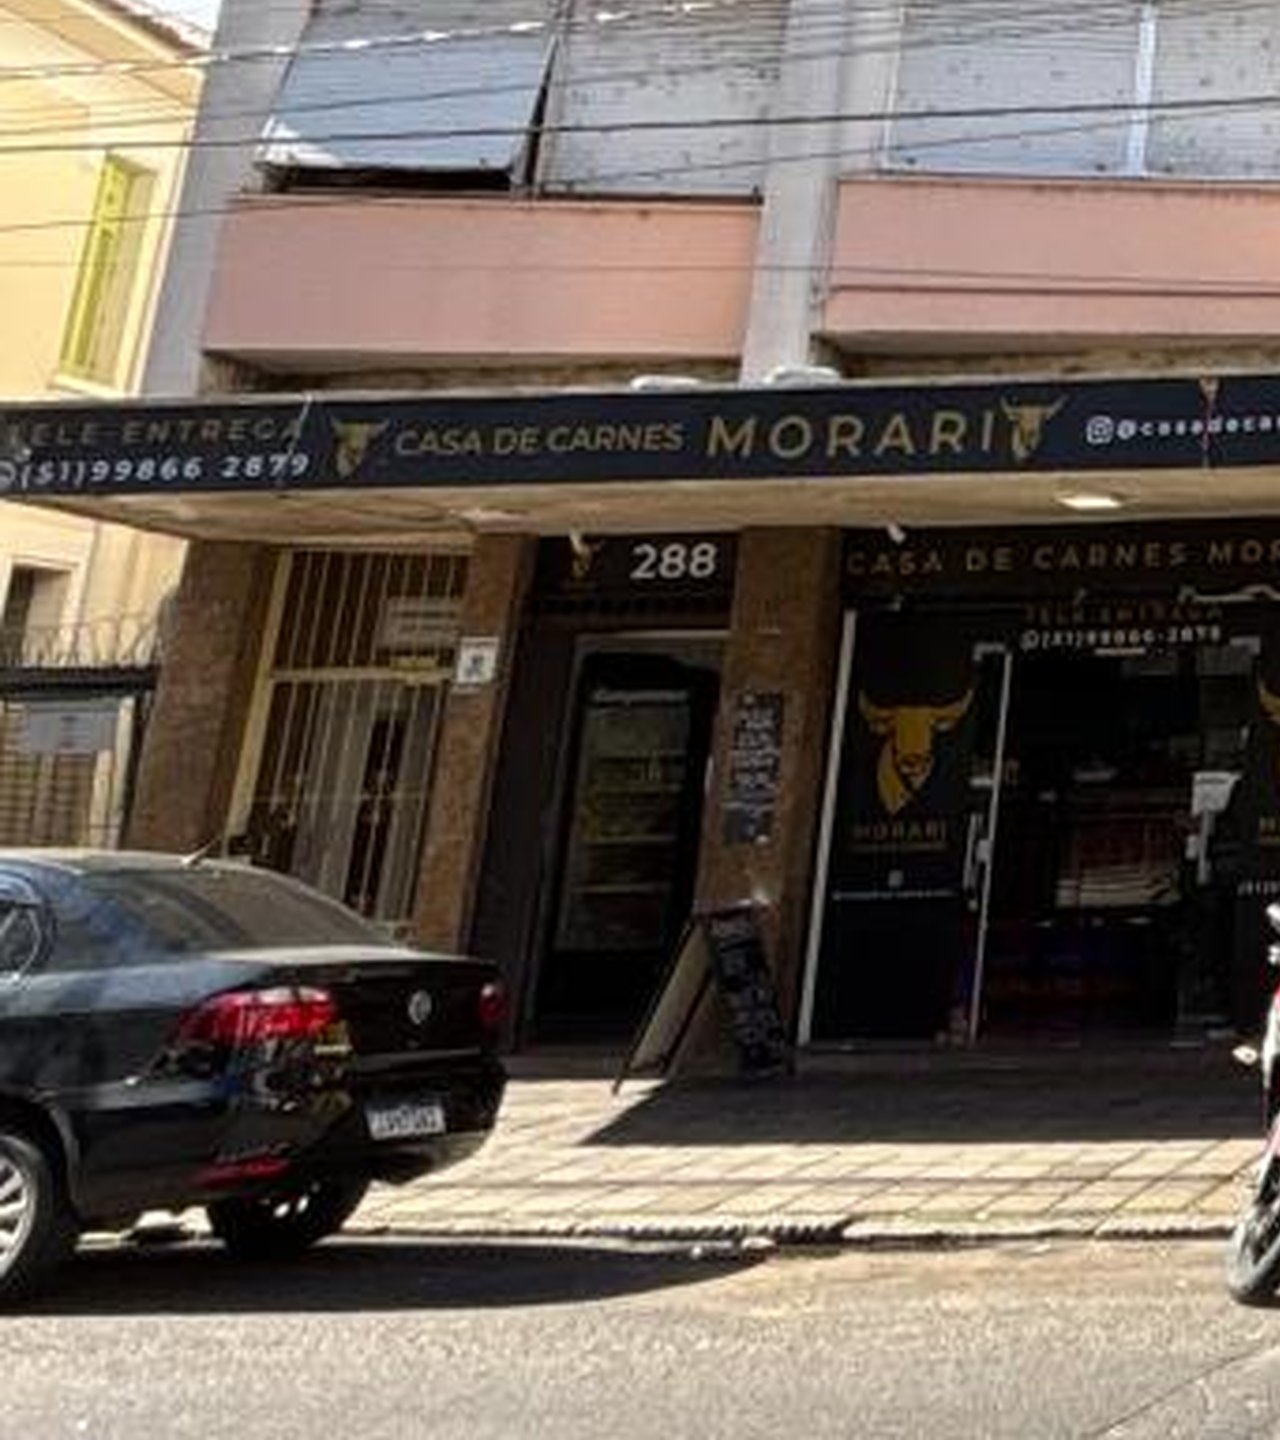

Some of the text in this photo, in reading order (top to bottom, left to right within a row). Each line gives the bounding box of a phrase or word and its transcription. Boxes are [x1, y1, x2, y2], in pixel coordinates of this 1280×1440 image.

[395, 411, 995, 459] CASA DE CARNES MORARI
[221, 452, 311, 478] 2879
[629, 542, 717, 580] 288
[846, 549, 944, 577] CASA
[965, 546, 1014, 572] DE
[1033, 541, 1188, 570] CARNES
